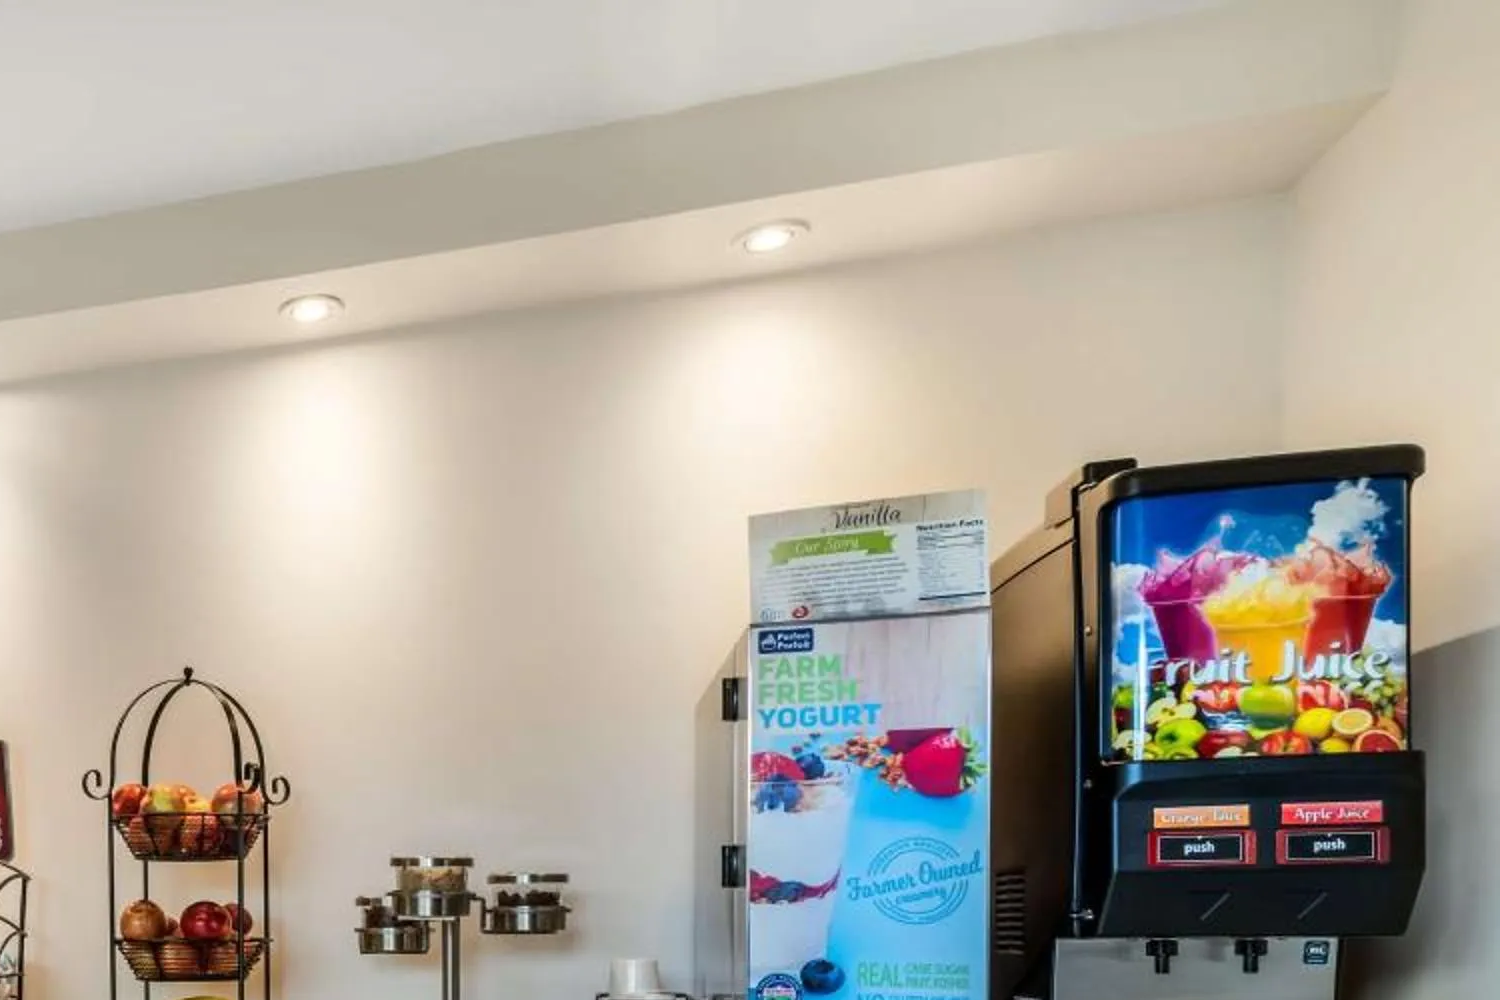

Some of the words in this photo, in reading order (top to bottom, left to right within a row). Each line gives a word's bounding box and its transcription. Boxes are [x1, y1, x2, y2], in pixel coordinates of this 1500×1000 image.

[834, 504, 901, 529] Vanilla
[959, 518, 984, 529] Facts
[758, 654, 841, 681] FARM
[1271, 639, 1391, 682] Juice
[758, 679, 858, 705] FRESH
[757, 703, 882, 729] YOGURT
[1293, 807, 1333, 823] Apple
[1337, 806, 1370, 820] Juice
[1184, 840, 1215, 855] push
[1313, 838, 1346, 853] push
[846, 873, 916, 901] Farmer
[919, 848, 984, 884] Owned
[857, 961, 903, 989] REAL
